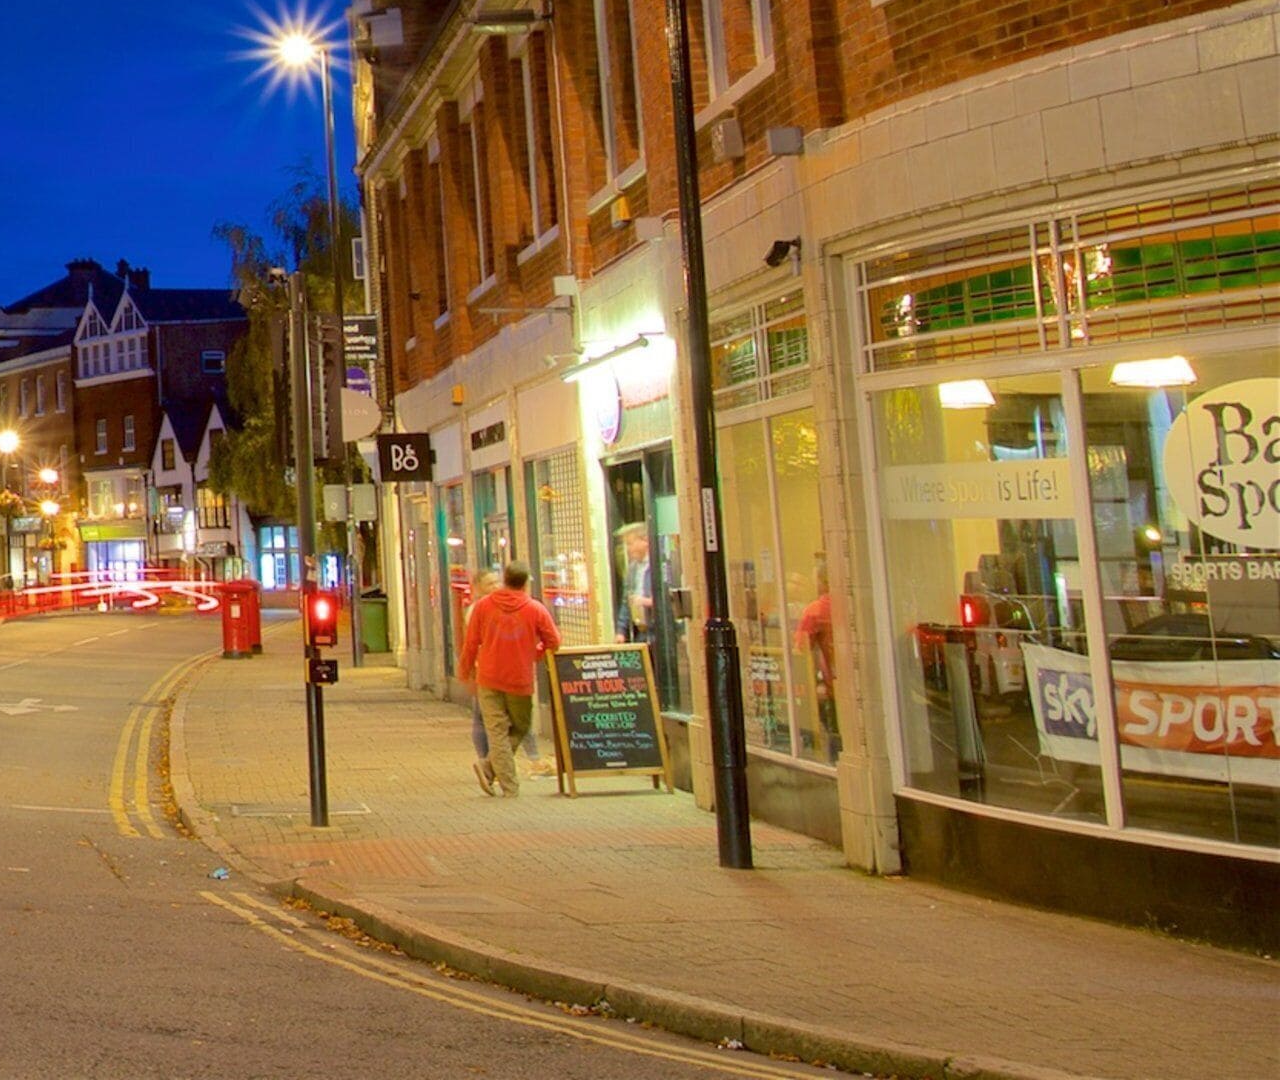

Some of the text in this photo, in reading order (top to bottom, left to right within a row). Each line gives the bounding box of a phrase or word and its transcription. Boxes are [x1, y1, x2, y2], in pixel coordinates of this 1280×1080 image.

[997, 472, 1012, 501] is
[1017, 469, 1058, 501] Life!
[1171, 563, 1243, 581] SPORTS
